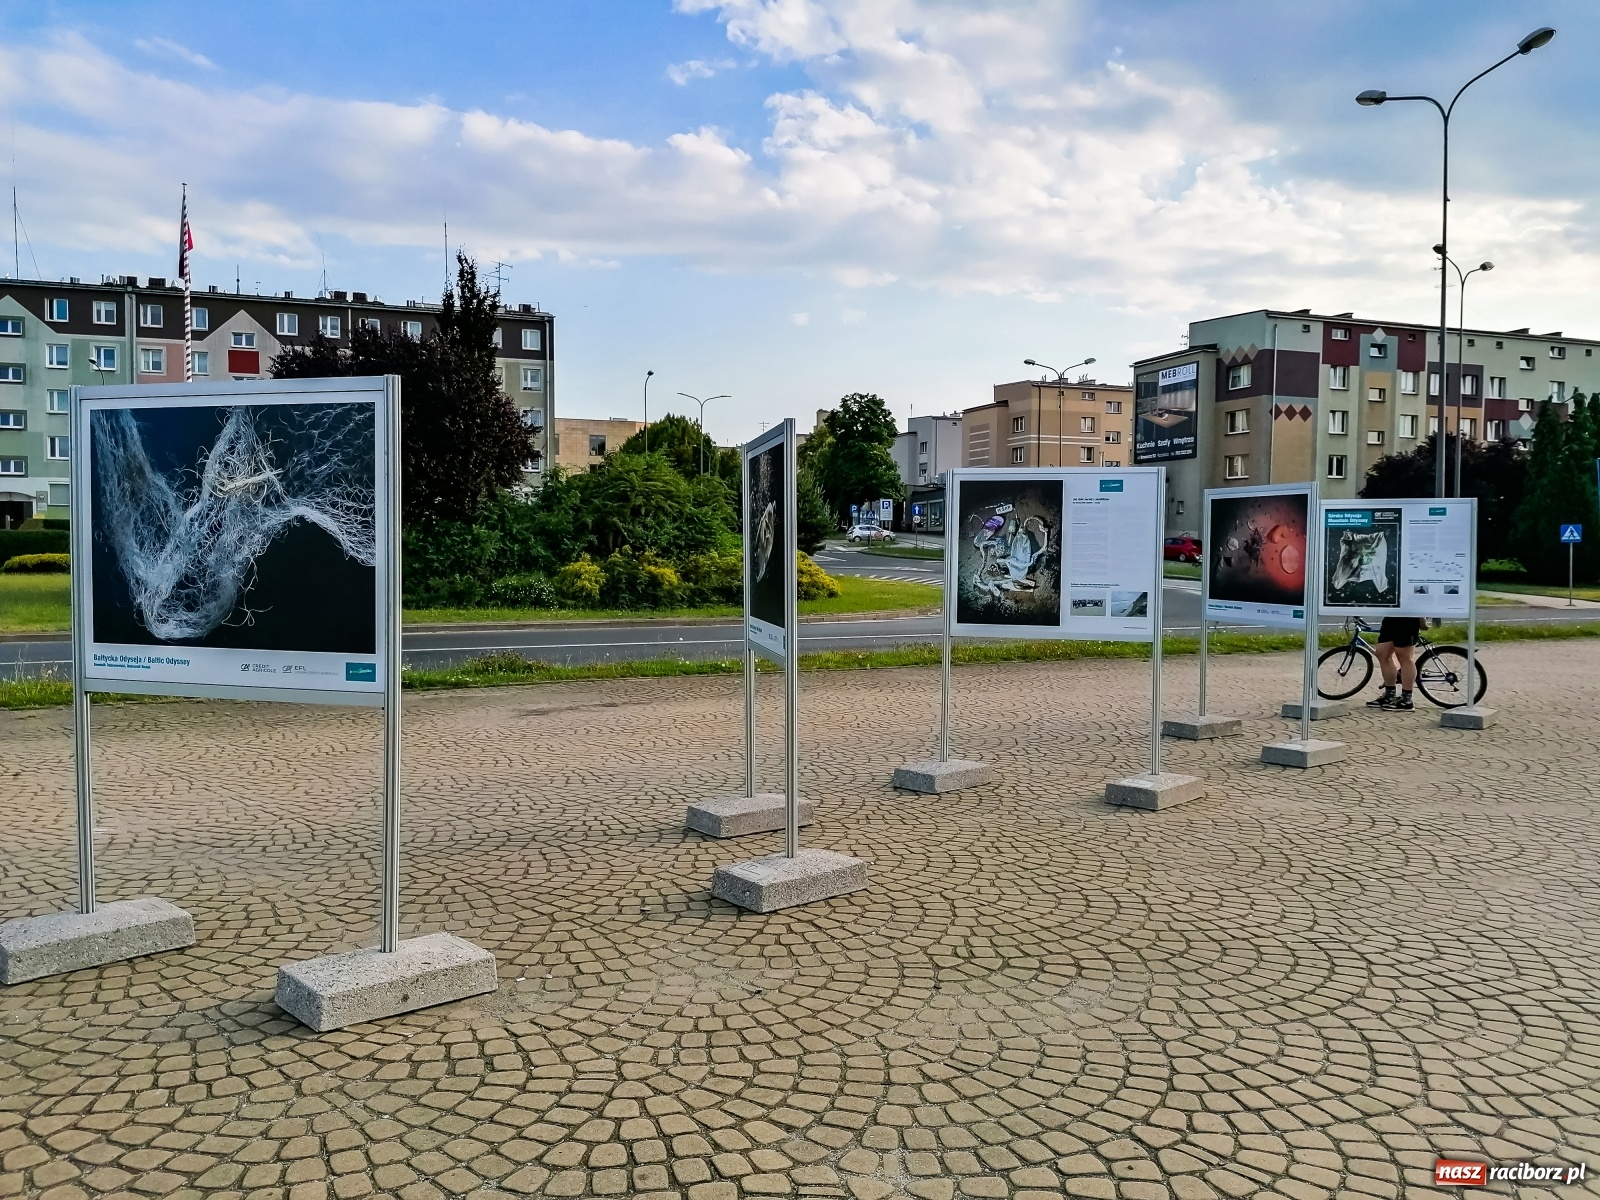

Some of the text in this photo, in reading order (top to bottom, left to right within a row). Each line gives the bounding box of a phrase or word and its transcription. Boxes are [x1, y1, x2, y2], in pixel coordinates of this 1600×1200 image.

[1161, 366, 1195, 380] MEBROLL
[1136, 441, 1156, 449] Kuchnie
[1157, 439, 1171, 447] Szafy
[1173, 436, 1195, 445] Wnętrza
[93, 653, 118, 663] Bałtycka
[119, 655, 142, 665] Odyseja
[147, 656, 164, 664] Baltic
[165, 657, 191, 666] Odyssey
